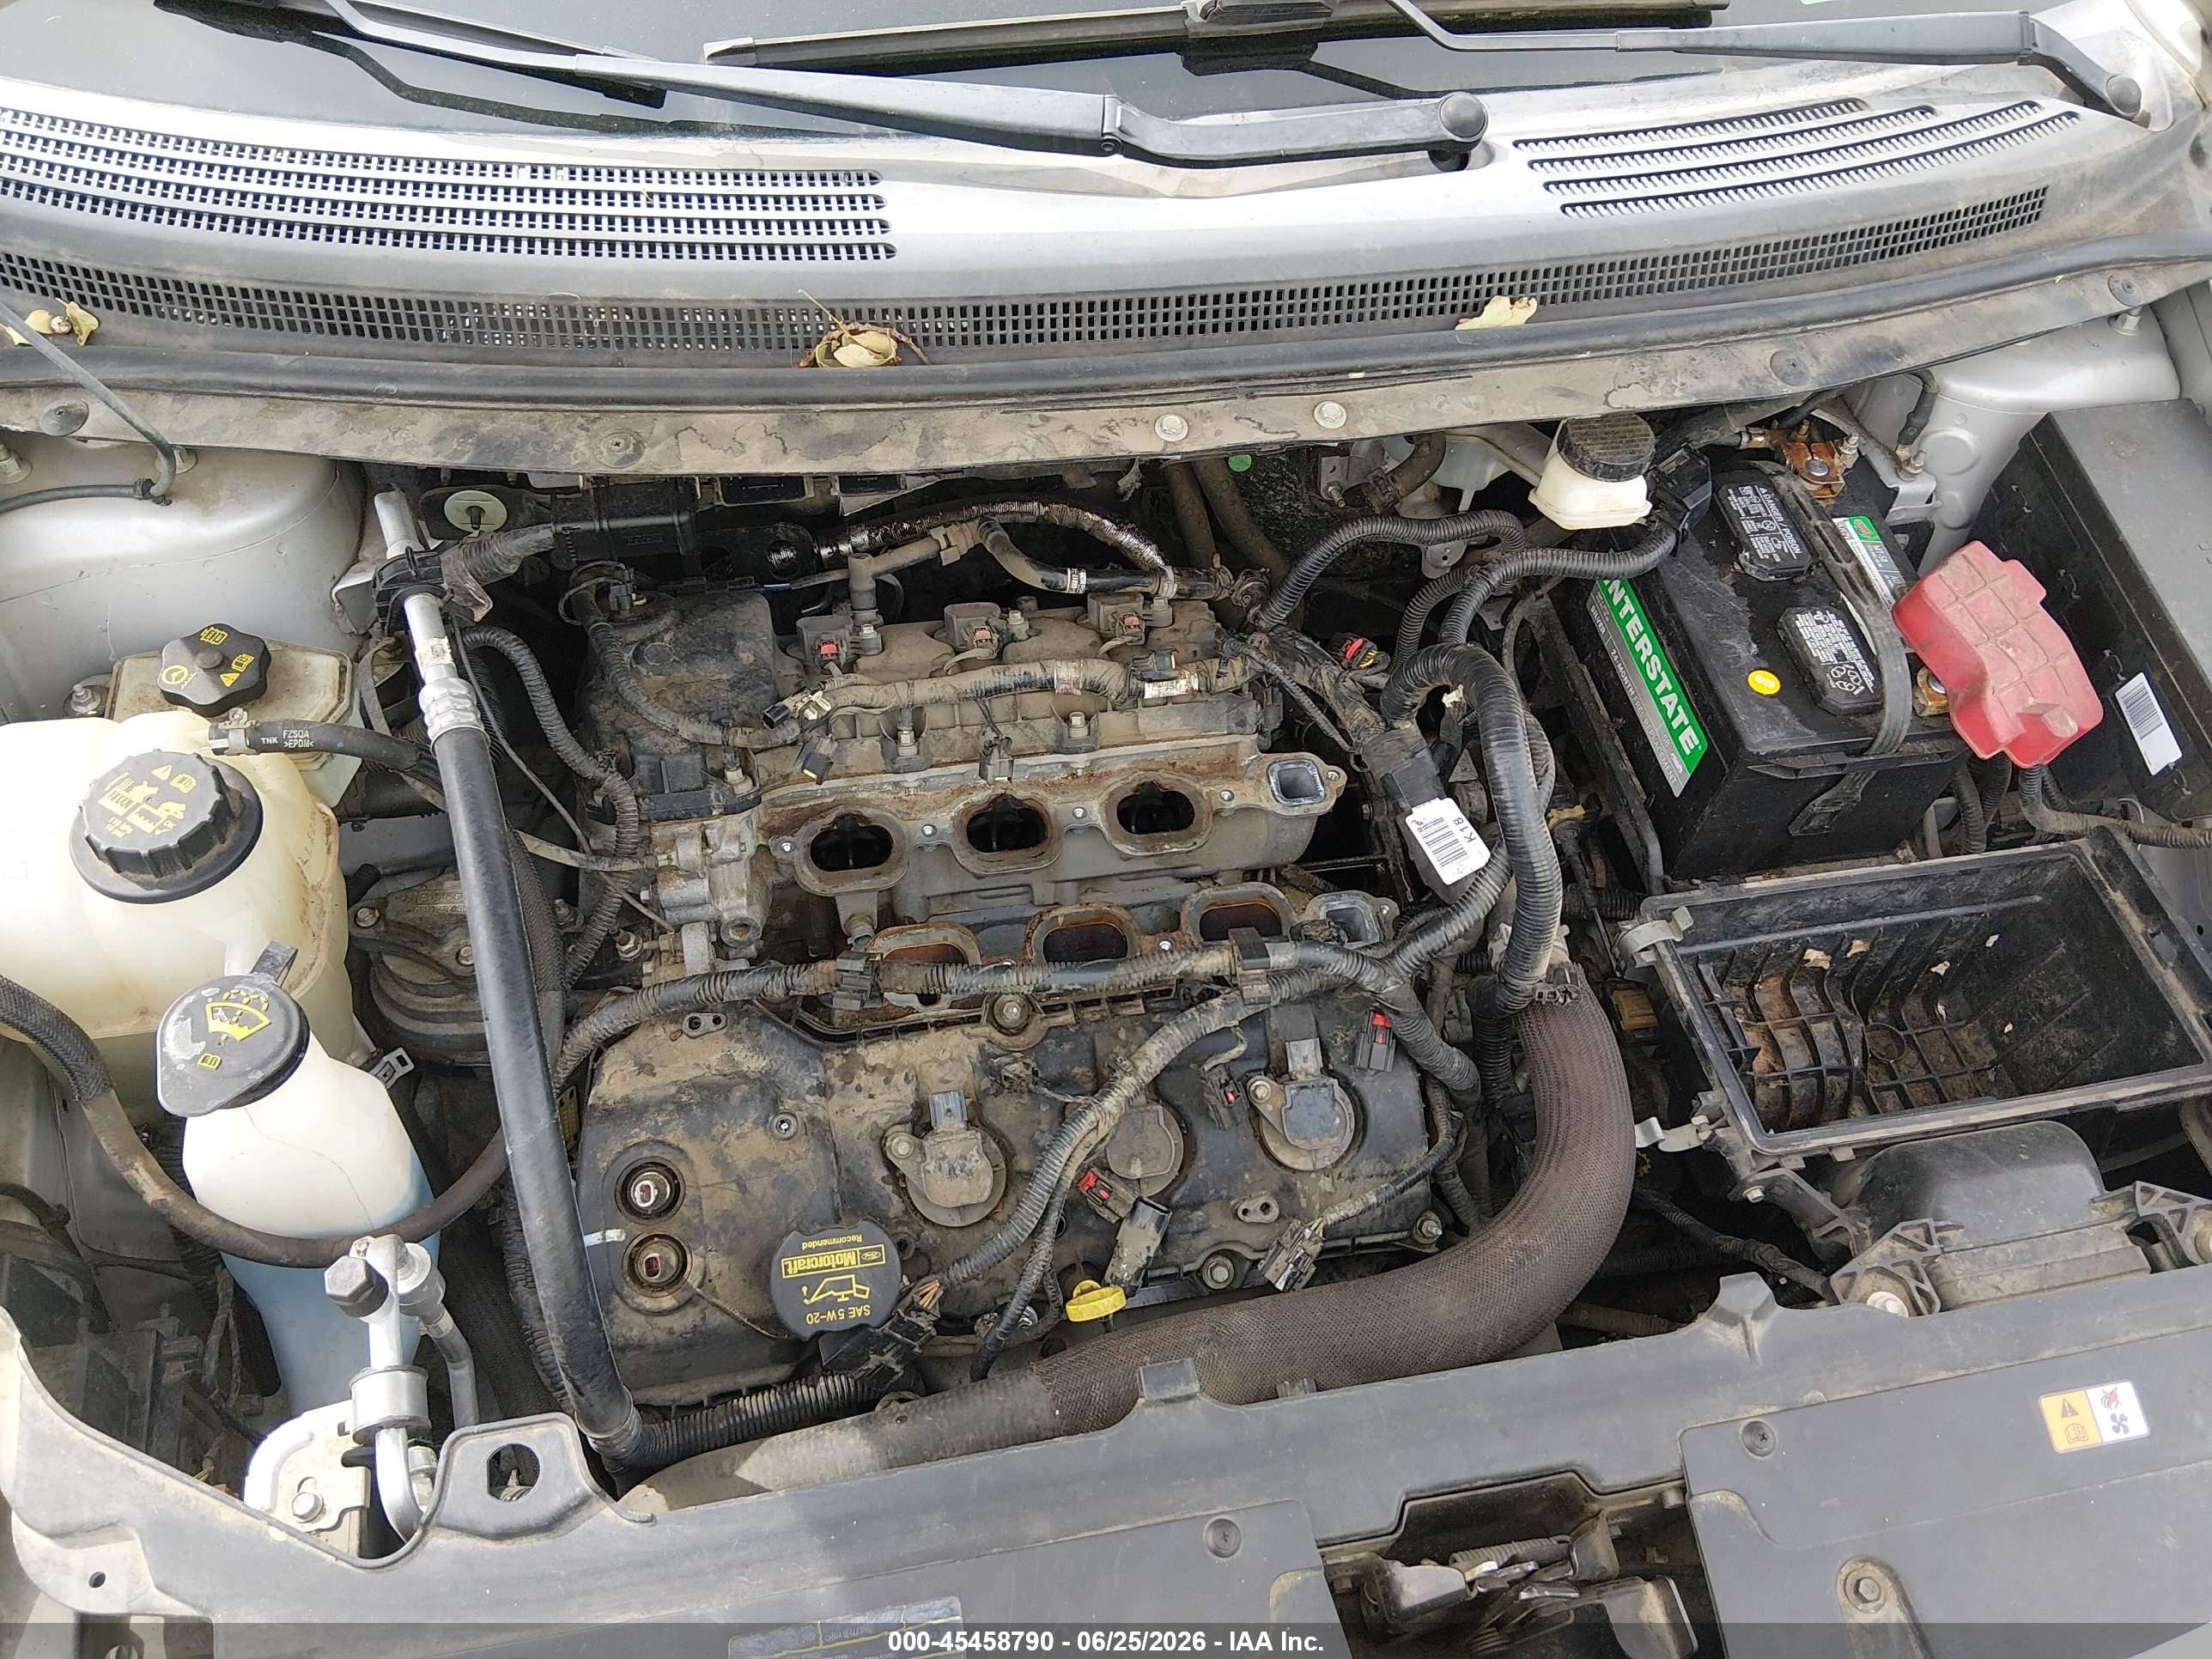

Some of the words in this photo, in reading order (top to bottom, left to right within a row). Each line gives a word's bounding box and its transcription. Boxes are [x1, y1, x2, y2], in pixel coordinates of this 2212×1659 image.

[1763, 494, 1784, 522] DANGER
[1782, 528, 1803, 554] POISON
[1590, 605, 1607, 635] SILVER
[1603, 580, 1700, 756] NTERSTATE
[1610, 648, 1638, 697] 24-MONTH
[1633, 696, 1646, 716] FREE
[1643, 718, 1677, 784] REPLACEMENT
[1453, 817, 1477, 843] K18
[802, 1234, 862, 1250] Recommended
[785, 1249, 857, 1274] Motorcraft
[848, 1304, 872, 1319] SAE
